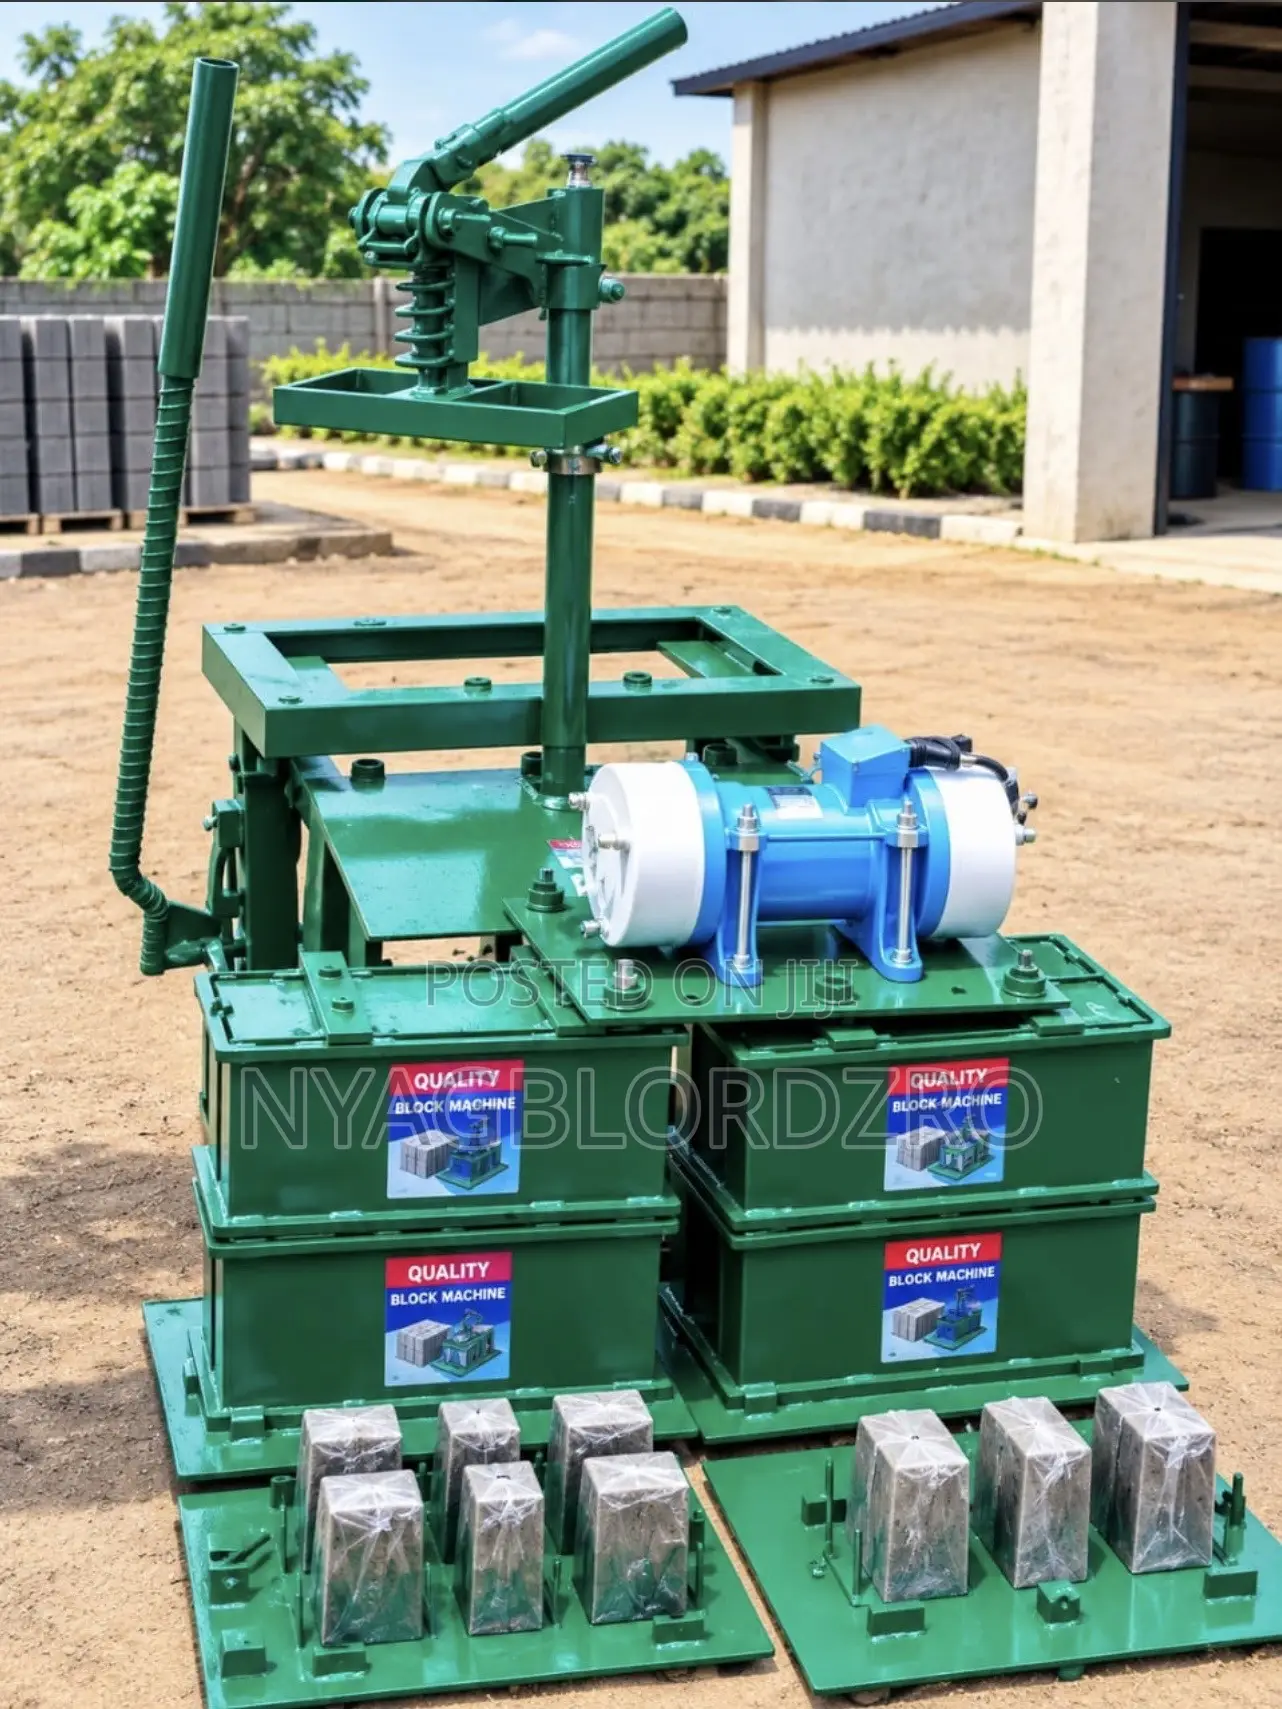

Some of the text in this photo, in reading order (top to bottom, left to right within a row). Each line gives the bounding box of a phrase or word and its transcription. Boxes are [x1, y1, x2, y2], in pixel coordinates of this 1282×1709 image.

[414, 1070, 500, 1090] QUALITY
[910, 1068, 988, 1089] QUALITY
[395, 1097, 516, 1114] BLOCK MACHINE
[892, 1093, 1003, 1113] BLOCK MACHINE
[906, 1243, 981, 1265] QUALITY
[408, 1262, 490, 1284] QUALITY
[888, 1266, 995, 1287] BLOCK MACHINE
[390, 1287, 506, 1306] BLOCK MACHINE
